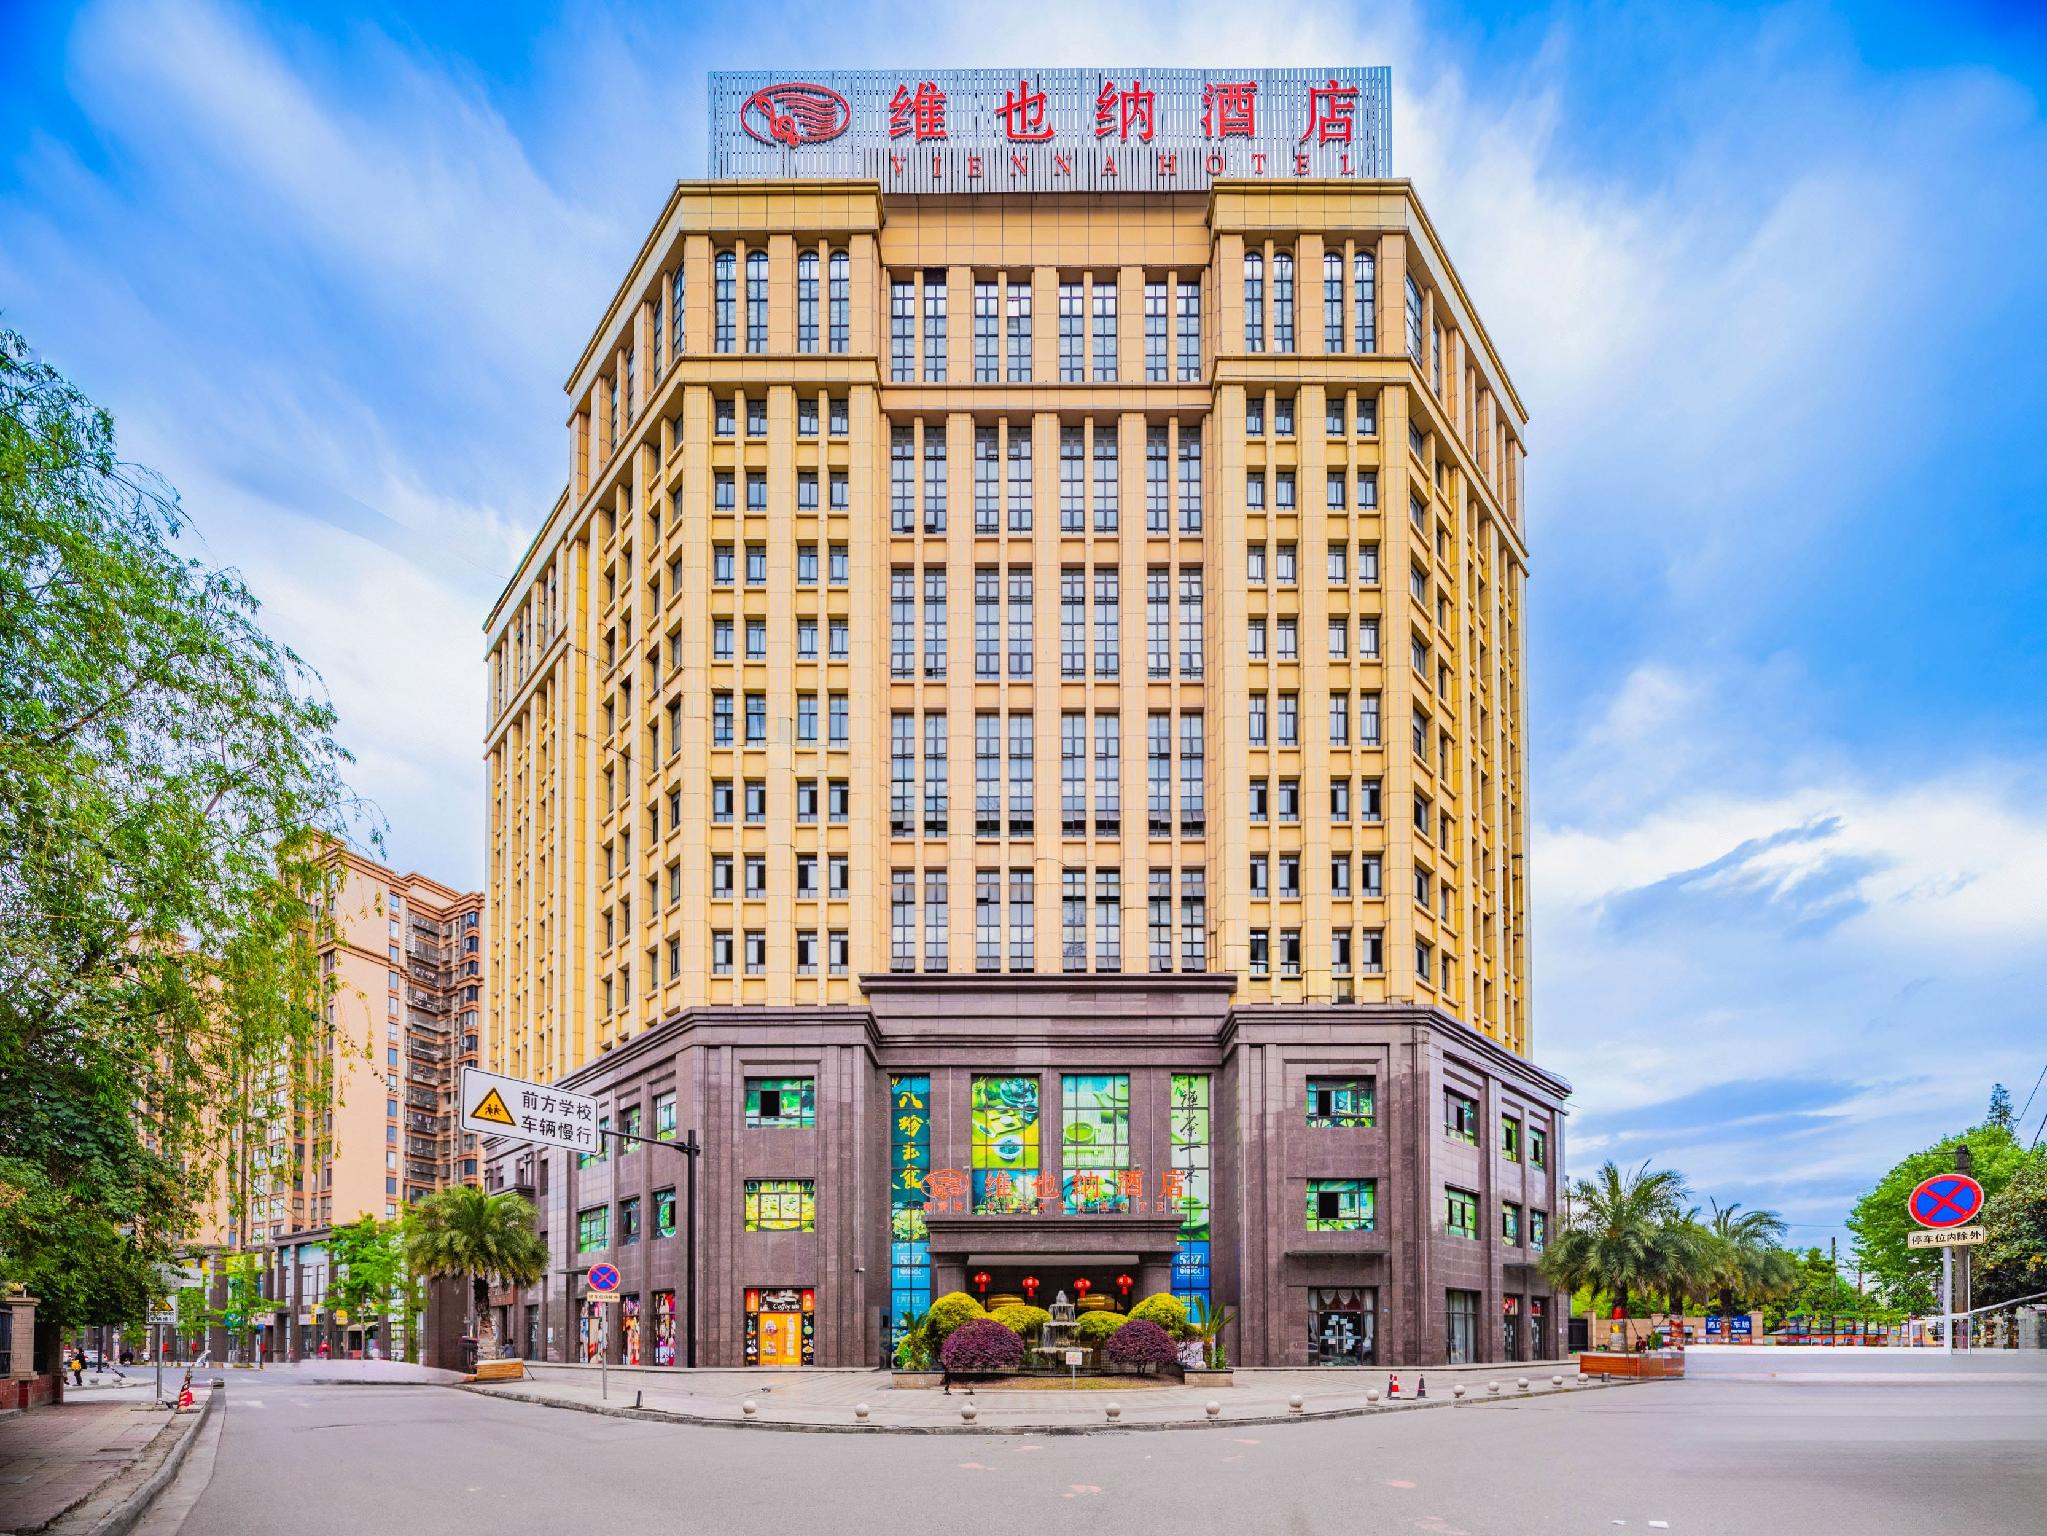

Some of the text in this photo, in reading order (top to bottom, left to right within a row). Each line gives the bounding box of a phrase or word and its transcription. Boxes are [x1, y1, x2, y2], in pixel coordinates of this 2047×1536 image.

[888, 80, 1359, 145] 维也纳酒店
[891, 153, 1356, 177] VIENNA HOTEL
[521, 1090, 592, 1122] 前方学校
[521, 1115, 592, 1145] 车辆慢行
[984, 1169, 1184, 1199] 维也纳酒店
[1912, 1230, 1982, 1245] 停车位内除外
